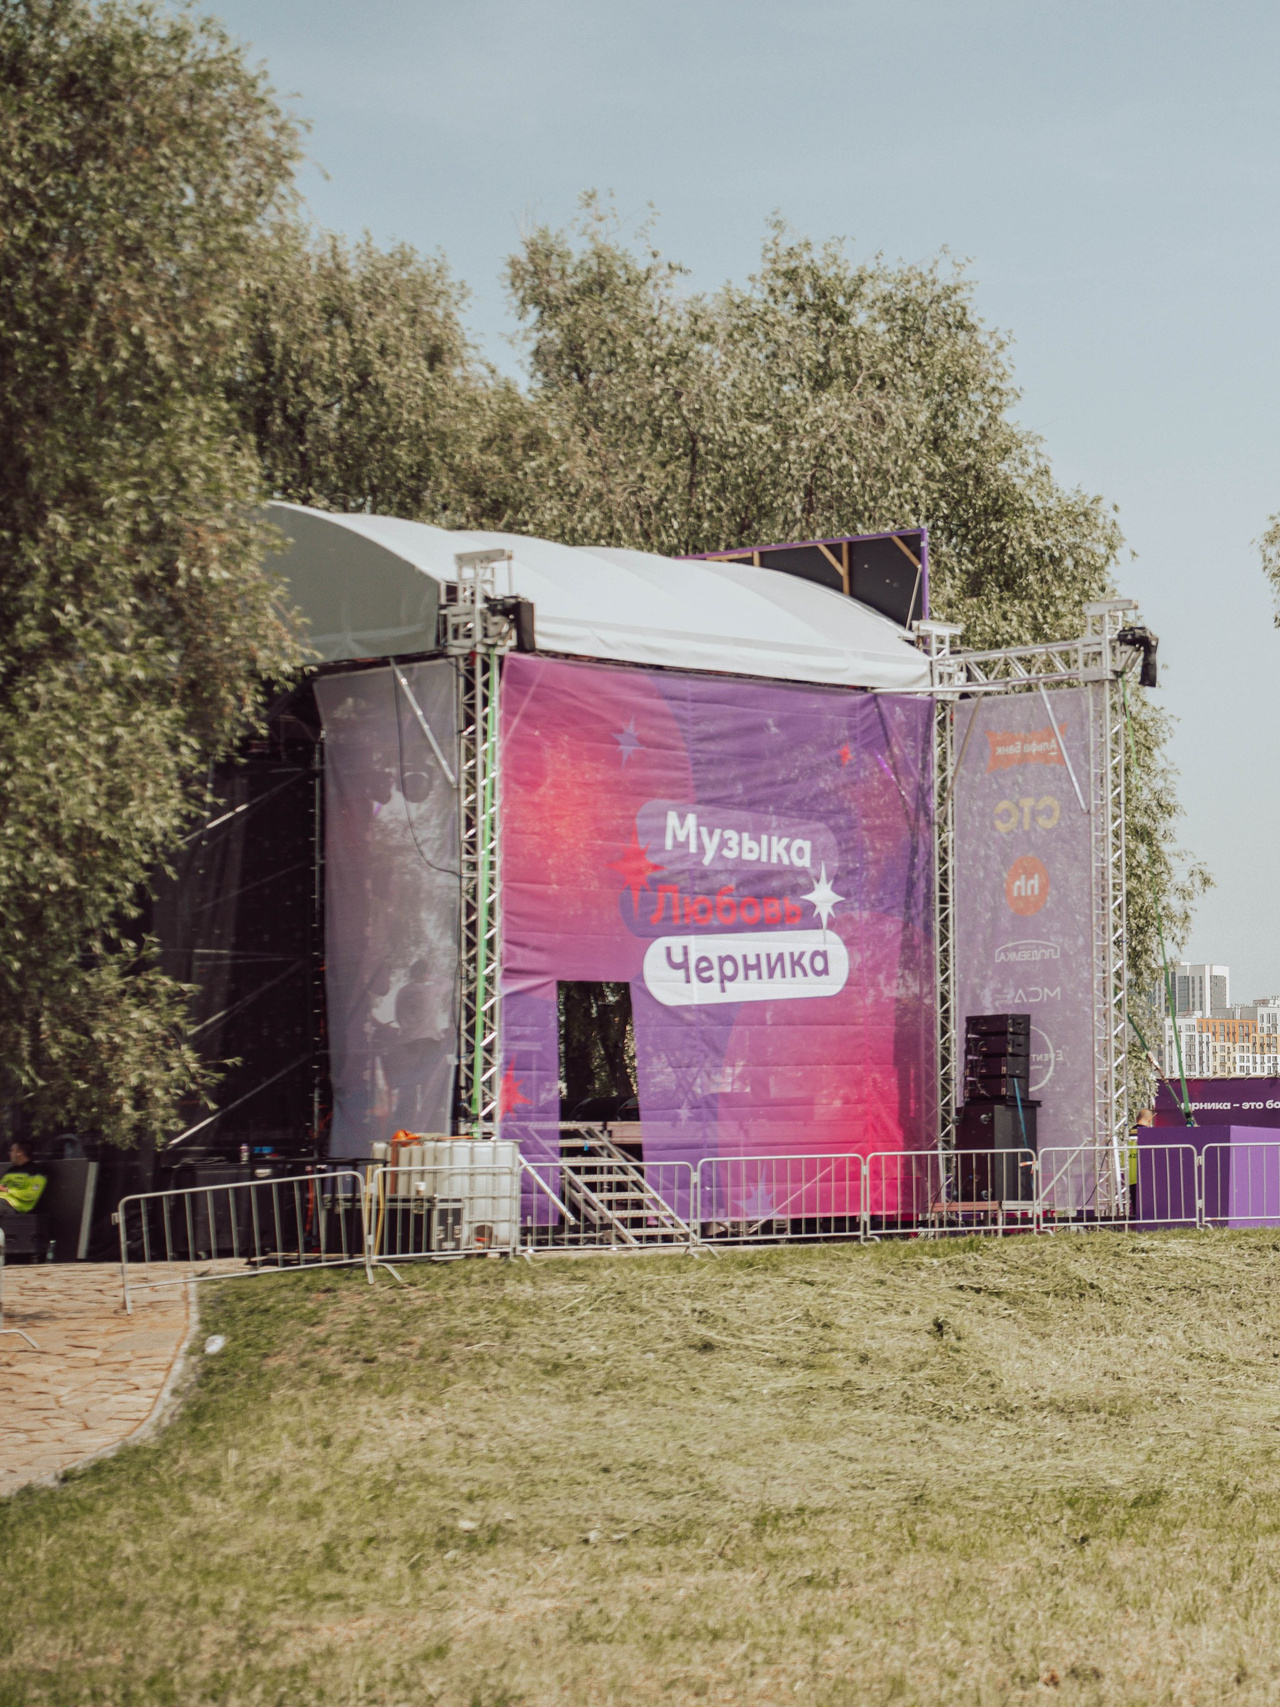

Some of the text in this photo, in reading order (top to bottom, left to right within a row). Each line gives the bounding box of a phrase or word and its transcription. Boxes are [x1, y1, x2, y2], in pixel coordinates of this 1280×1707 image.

[664, 810, 813, 868] Музыка
[650, 884, 803, 926] Любовь
[665, 945, 830, 993] Черника
[1242, 1101, 1264, 1110] это
